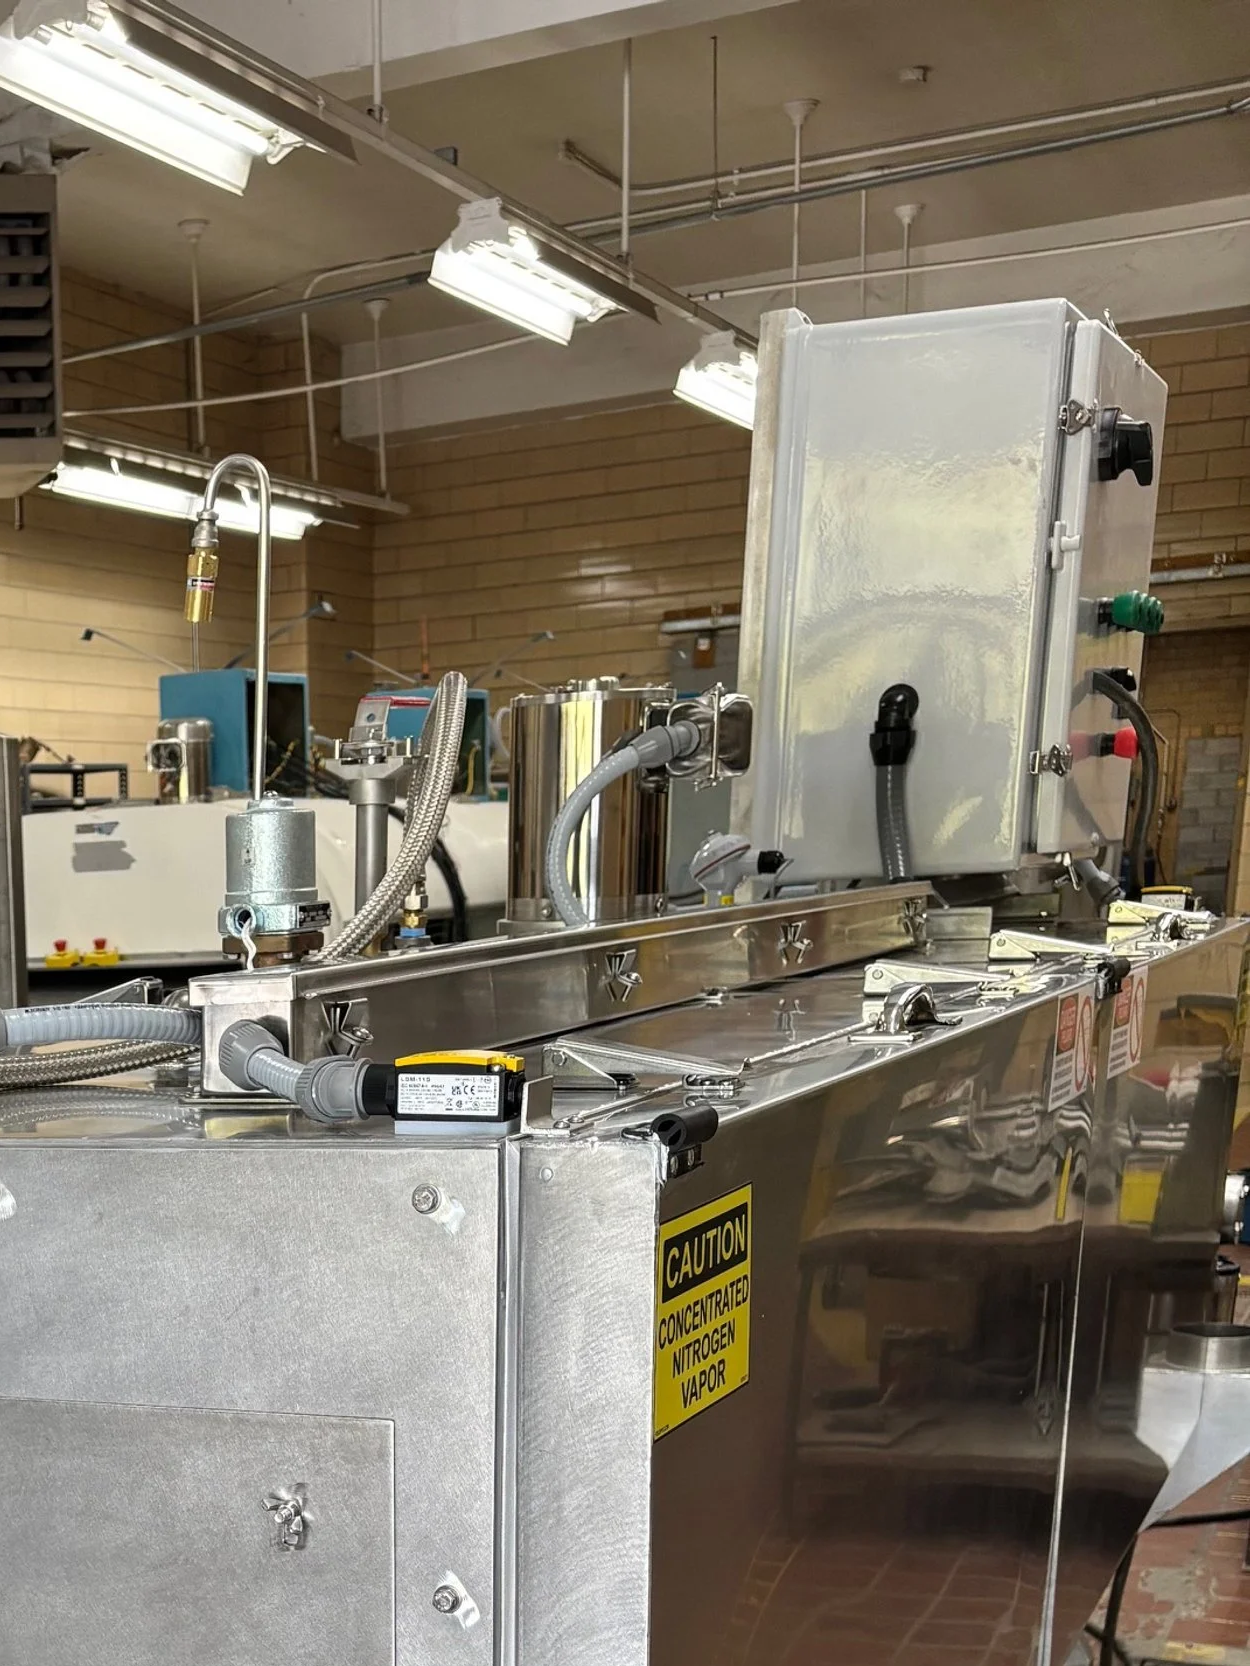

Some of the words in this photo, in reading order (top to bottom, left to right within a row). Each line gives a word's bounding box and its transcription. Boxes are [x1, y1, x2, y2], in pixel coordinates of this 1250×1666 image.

[666, 1214, 746, 1289] CAUTION
[658, 1274, 750, 1350] CONCENTRATED
[672, 1318, 736, 1378] NITROGEN
[681, 1358, 726, 1409] VAPOR
